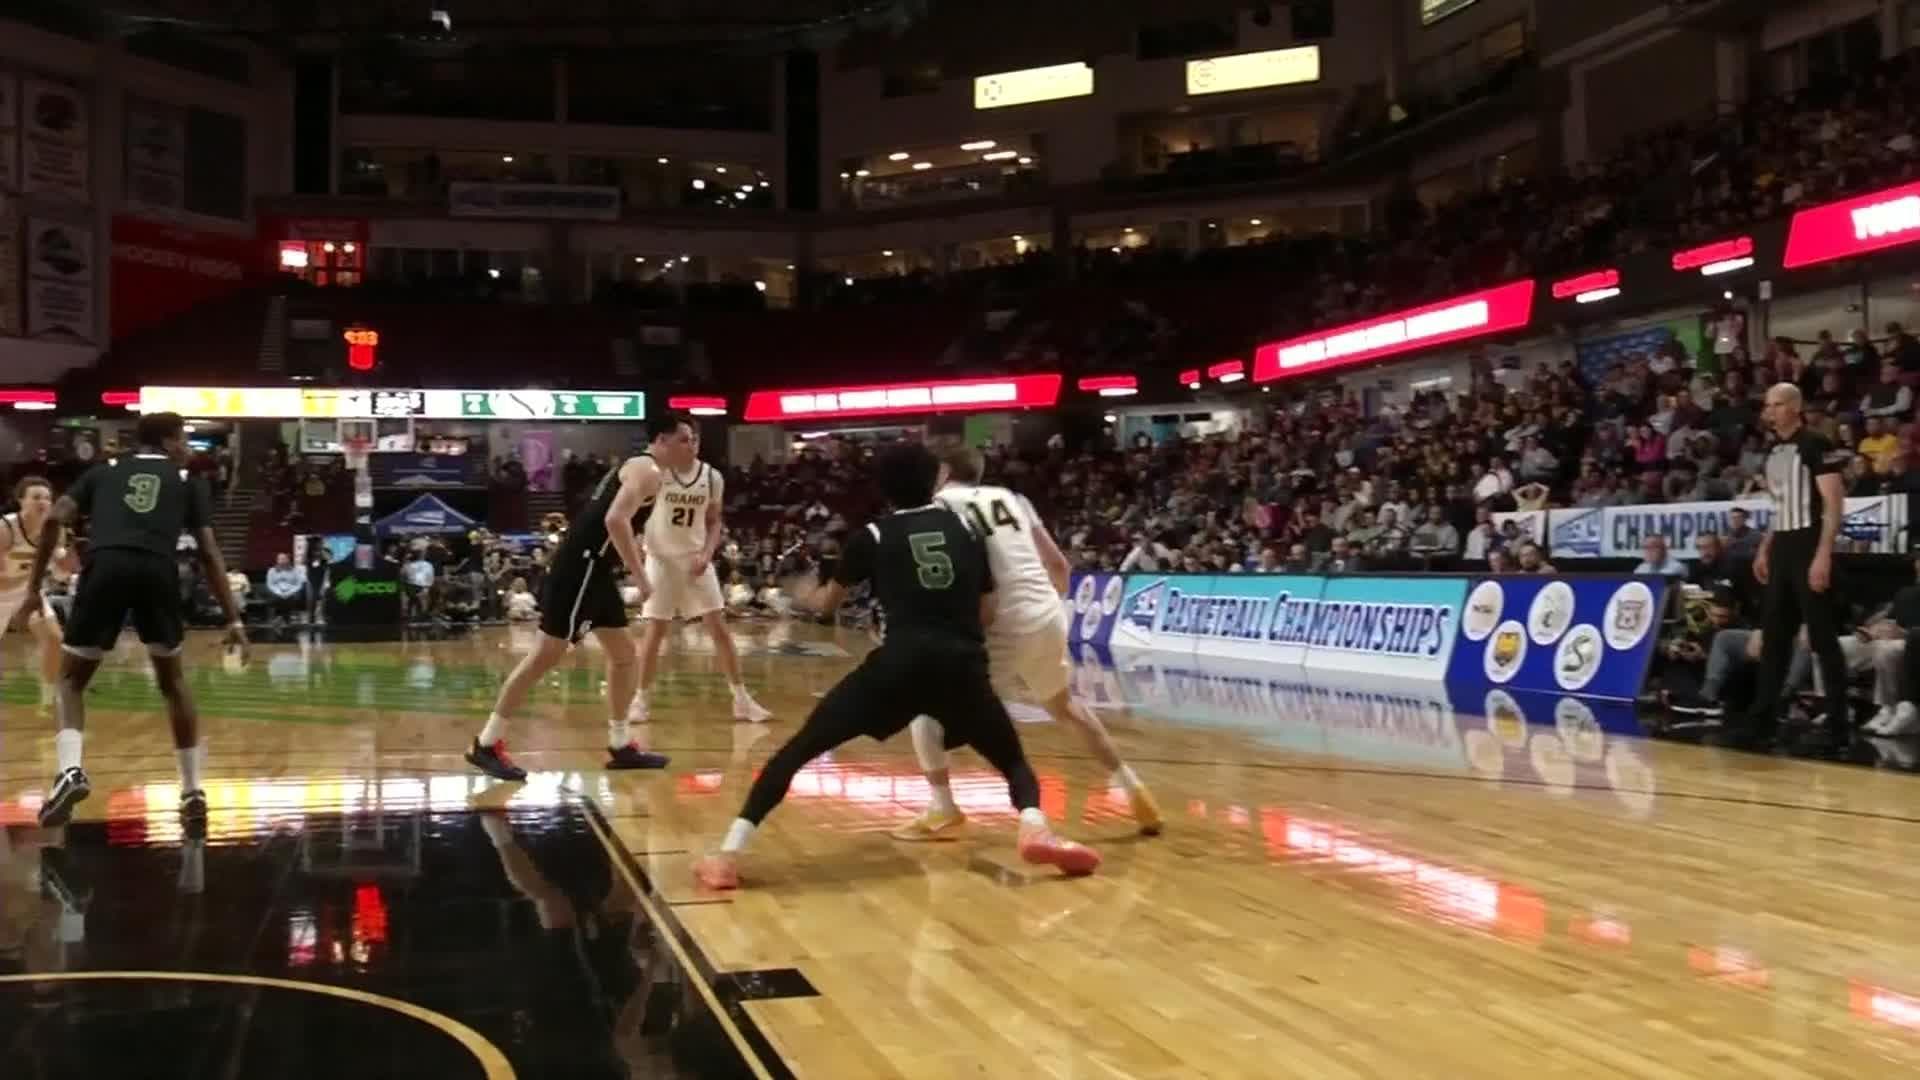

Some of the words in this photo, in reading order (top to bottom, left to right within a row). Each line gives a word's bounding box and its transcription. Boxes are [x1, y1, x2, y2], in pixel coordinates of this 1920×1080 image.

[124, 473, 161, 513] 3
[665, 492, 706, 505] IDAHO
[671, 507, 696, 527] 21
[967, 499, 1021, 536] 14
[908, 531, 955, 589] 5
[1160, 587, 1270, 638] BASKETBALL
[1268, 591, 1451, 656] CHAMPIONSHIPS
